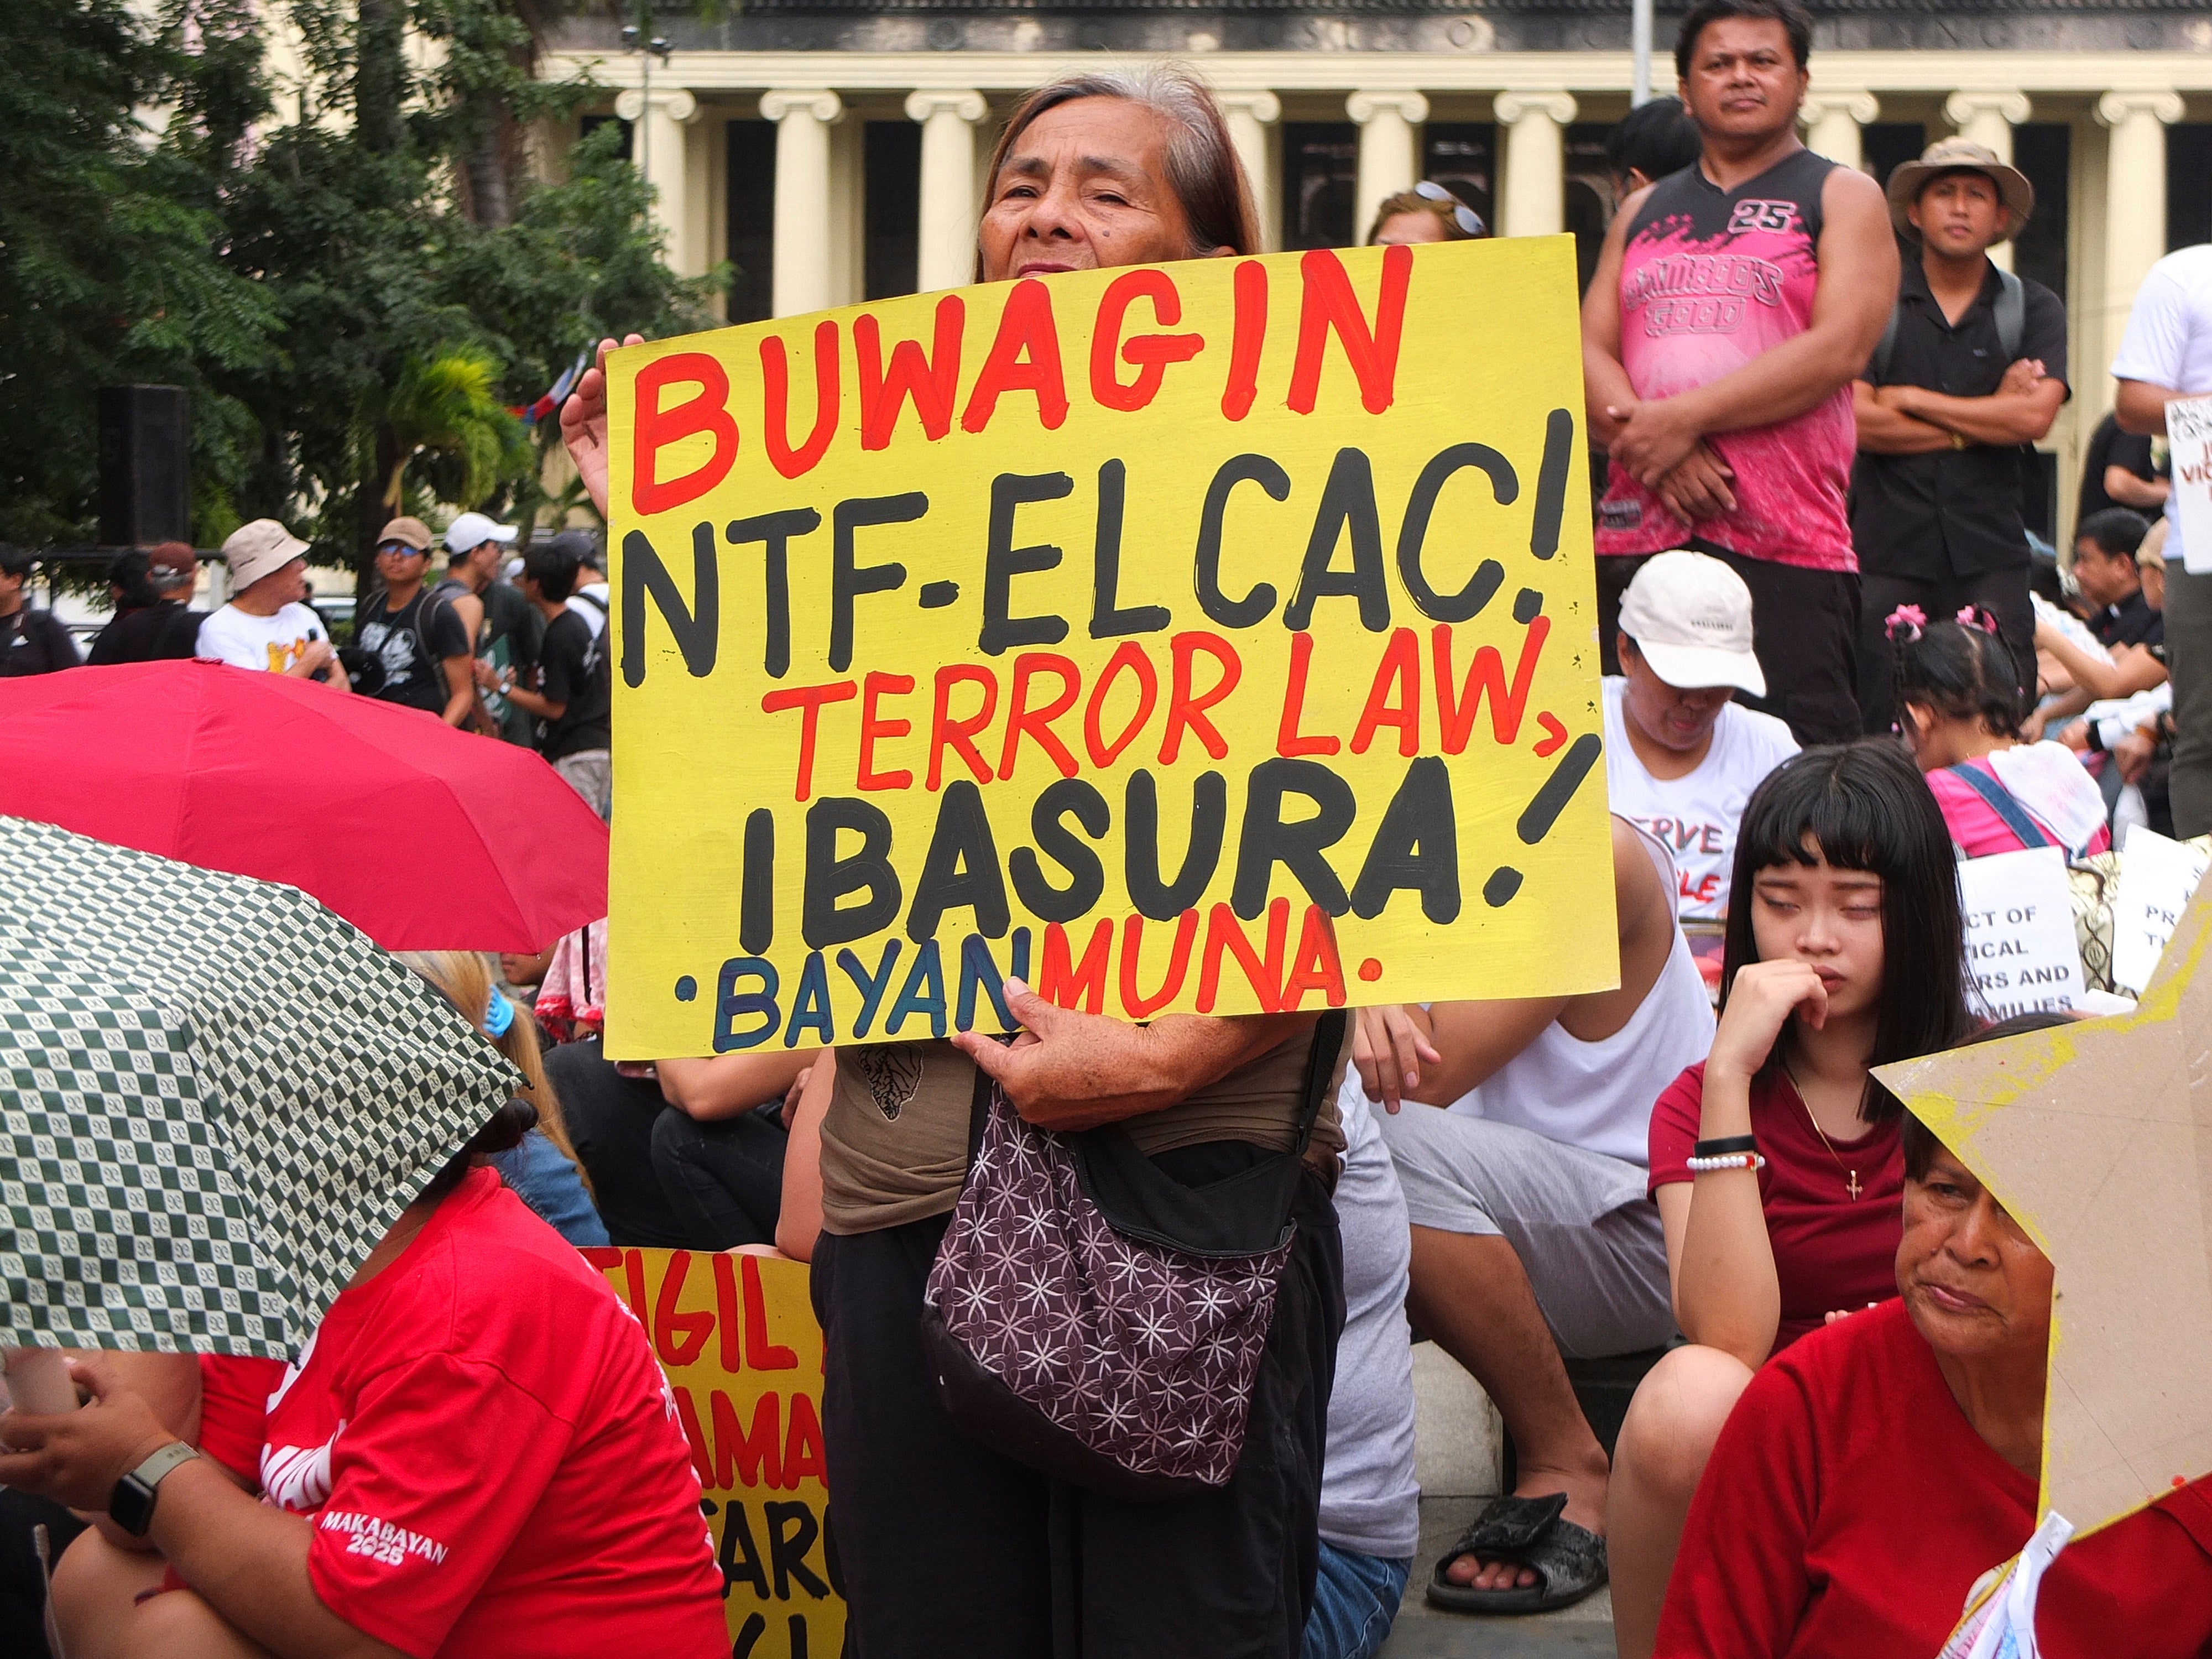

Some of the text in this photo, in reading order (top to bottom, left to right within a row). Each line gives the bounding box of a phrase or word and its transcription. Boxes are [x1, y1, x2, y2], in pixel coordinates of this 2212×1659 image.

[1728, 200, 1796, 233] 25
[632, 245, 1412, 515] BUWAGIN
[620, 408, 1573, 685] NTF-ELCAC!
[762, 630, 1241, 801] TERROR
[1628, 816, 1724, 854] RVE
[1677, 870, 1720, 902] LE
[1966, 906, 2037, 929] CT OF
[1969, 937, 2030, 961] ICAL
[1978, 966, 2070, 991] RS AND
[320, 1511, 448, 1566] MAKABAYAN
[346, 1533, 405, 1566] 2025
[702, 1499, 847, 1601] AR
